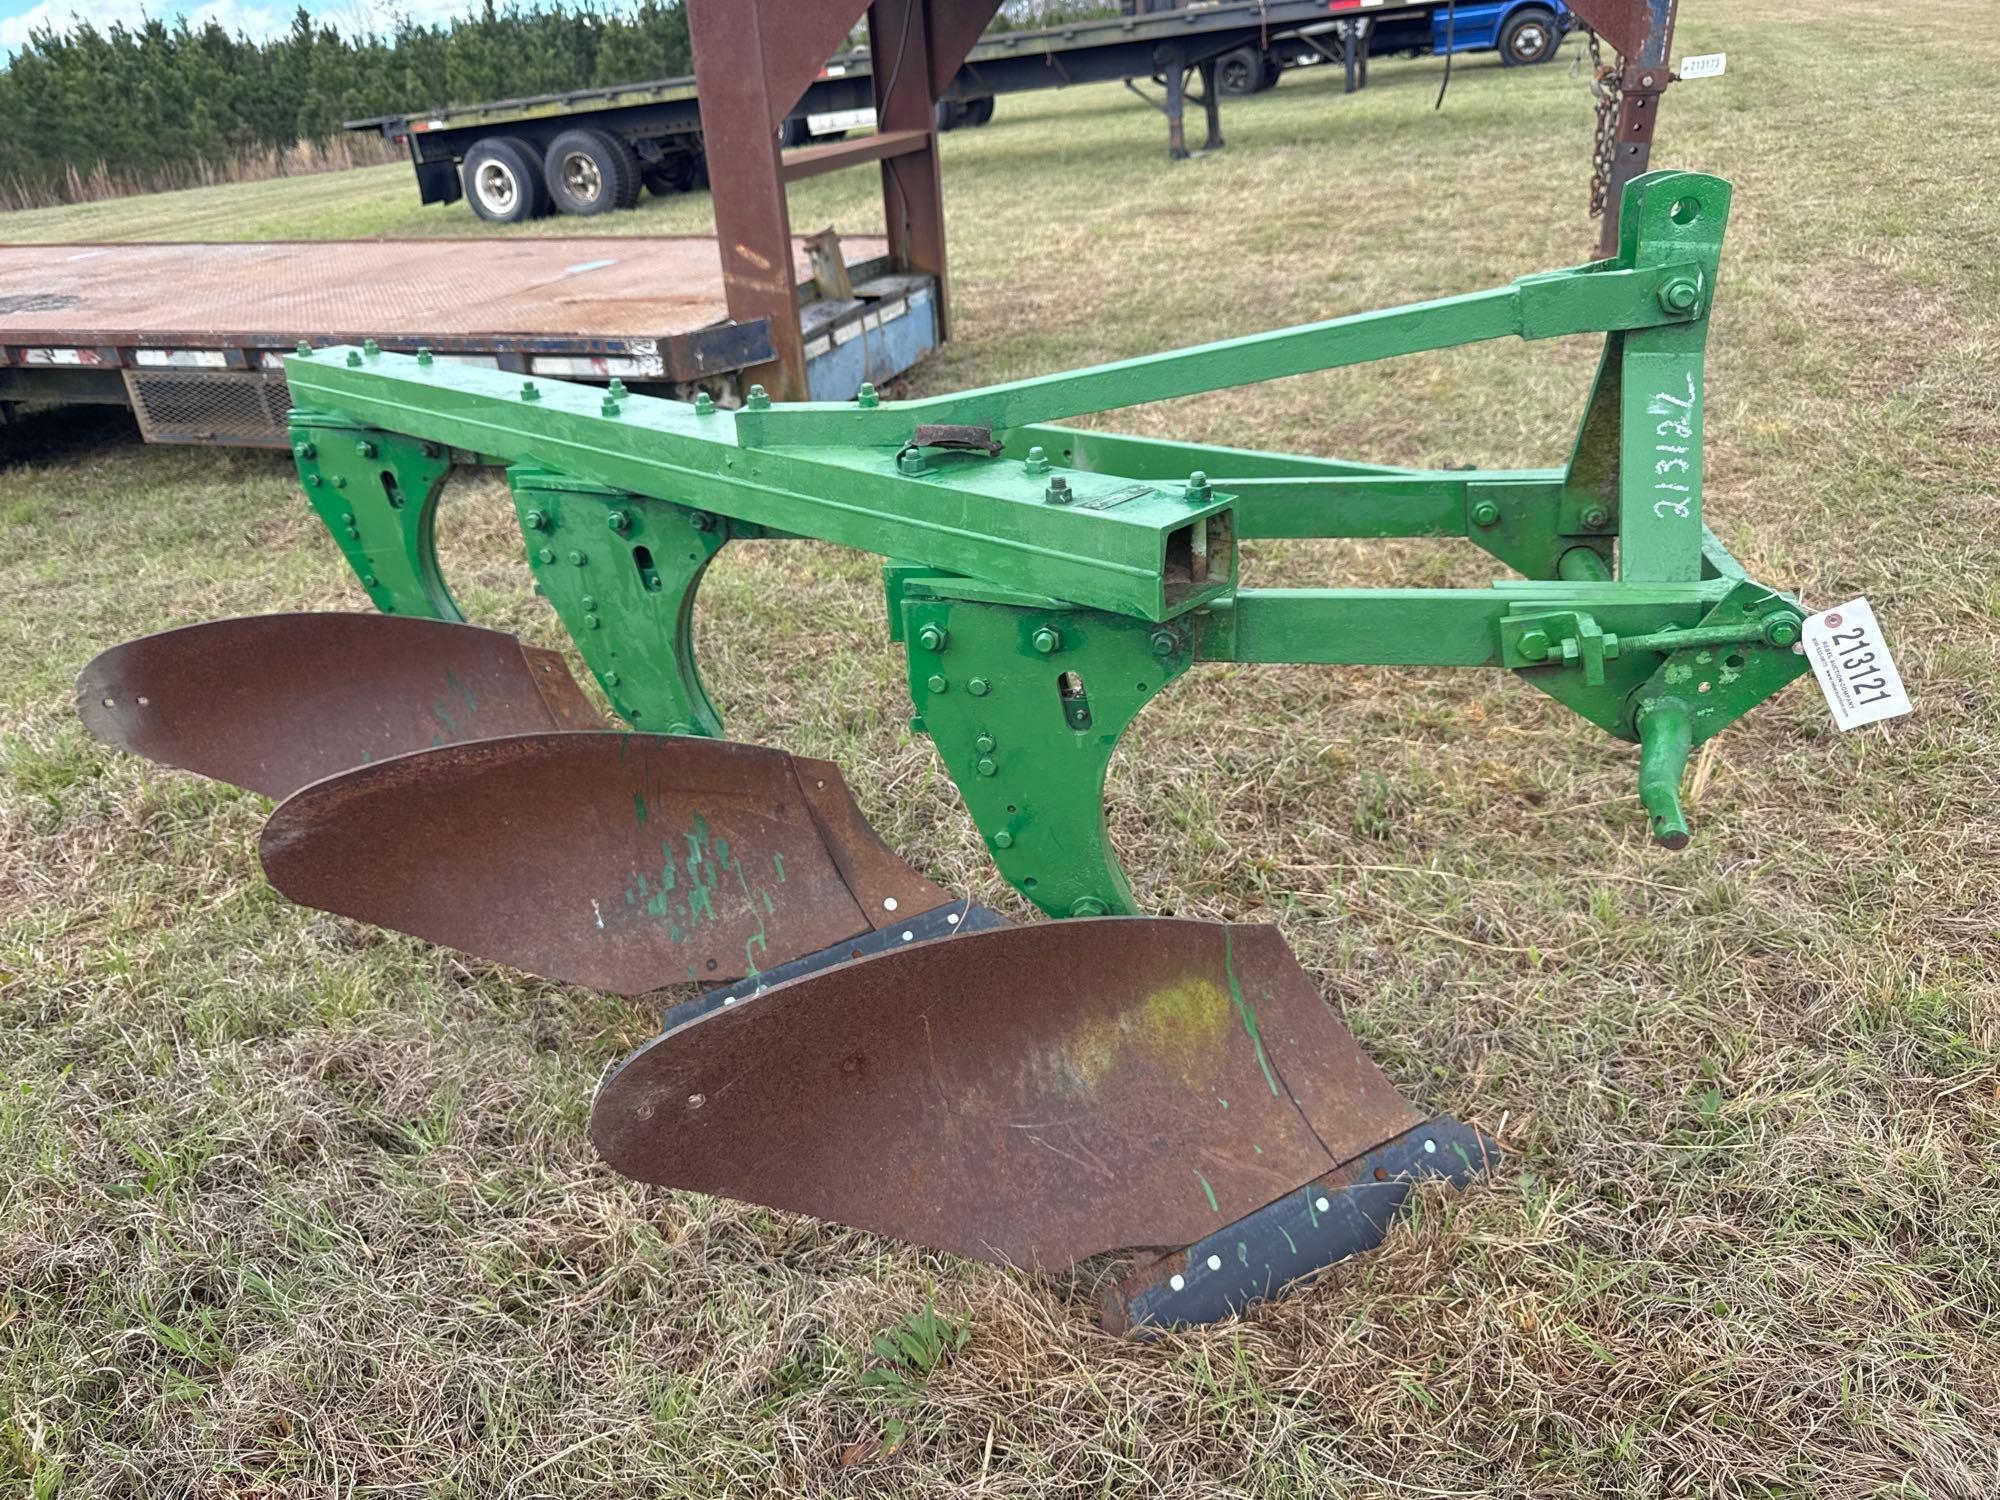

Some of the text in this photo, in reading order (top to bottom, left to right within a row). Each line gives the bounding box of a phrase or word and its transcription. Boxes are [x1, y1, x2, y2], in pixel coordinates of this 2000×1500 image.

[1822, 640, 1855, 709] REBEL AUCTION COMPANY
[1832, 627, 1891, 705] 213121
